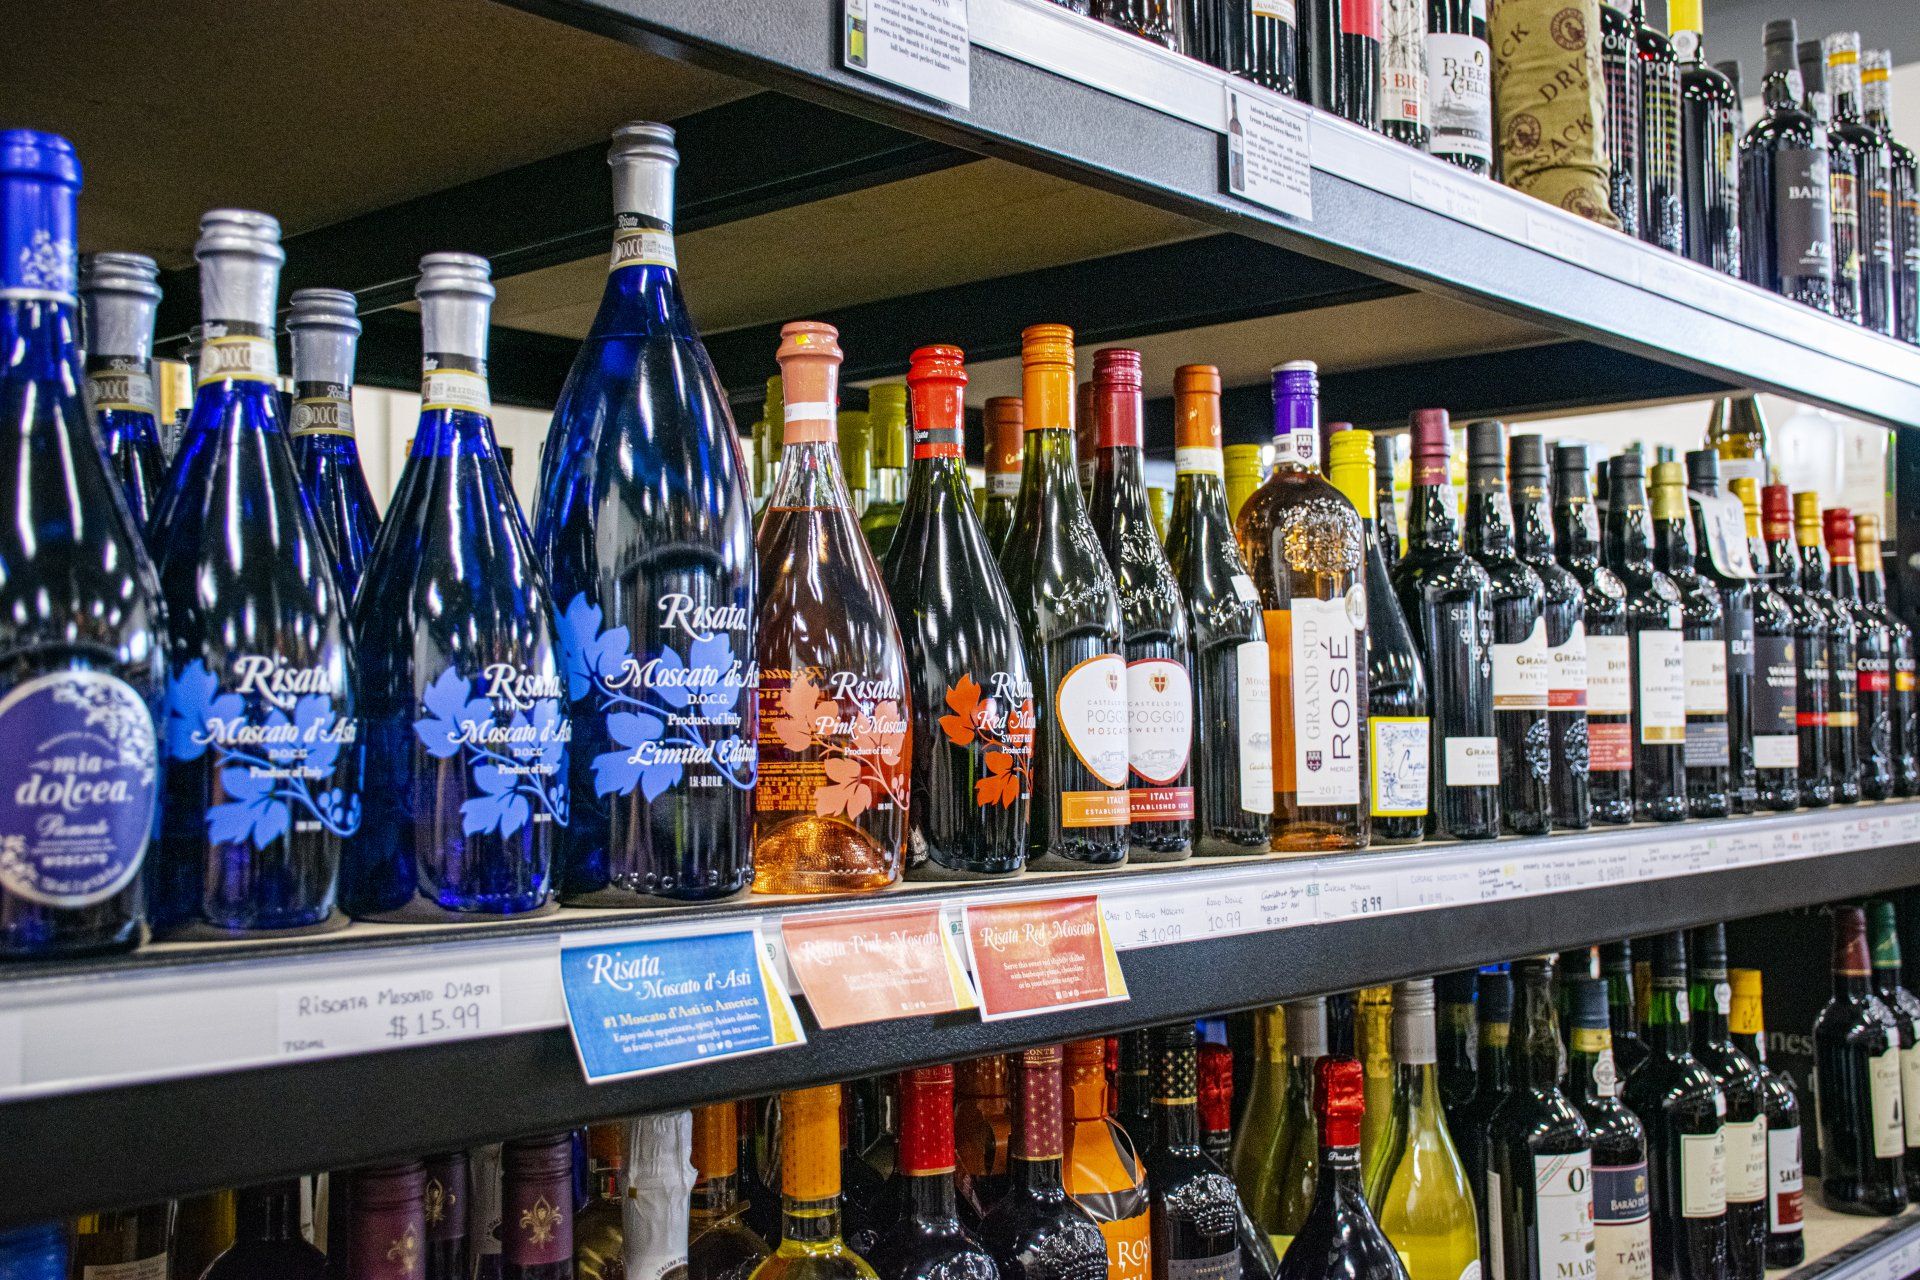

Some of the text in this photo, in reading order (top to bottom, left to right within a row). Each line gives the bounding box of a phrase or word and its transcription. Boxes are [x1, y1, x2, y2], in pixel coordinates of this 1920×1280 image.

[1539, 57, 1587, 102] DRY
[1533, 113, 1593, 166] SACK
[658, 592, 746, 642] Risata
[1303, 620, 1317, 661] SUD
[605, 658, 718, 689] Moscato
[1305, 667, 1320, 739] GRAND
[1321, 635, 1351, 759] ROSÉ
[668, 713, 709, 727] Product
[712, 713, 723, 725] of
[816, 715, 859, 740] Pink
[977, 710, 1008, 737] Red
[1088, 709, 1125, 723] POGG
[1128, 711, 1185, 723] POGGIO
[191, 717, 299, 746] Moscato
[447, 719, 536, 744] Moscato
[628, 739, 713, 766] Limited
[1131, 803, 1176, 811] STABLISHED
[1150, 792, 1174, 801] ITALY
[980, 926, 1019, 952] Risata
[1048, 920, 1096, 940] Moscato
[587, 951, 660, 992] Risata
[636, 968, 751, 1000] Moscato d'Asti
[619, 1011, 667, 1027] Moscato
[668, 1004, 701, 1020] d'Asti
[716, 997, 759, 1012] America
[1617, 1249, 1650, 1265] TAW
